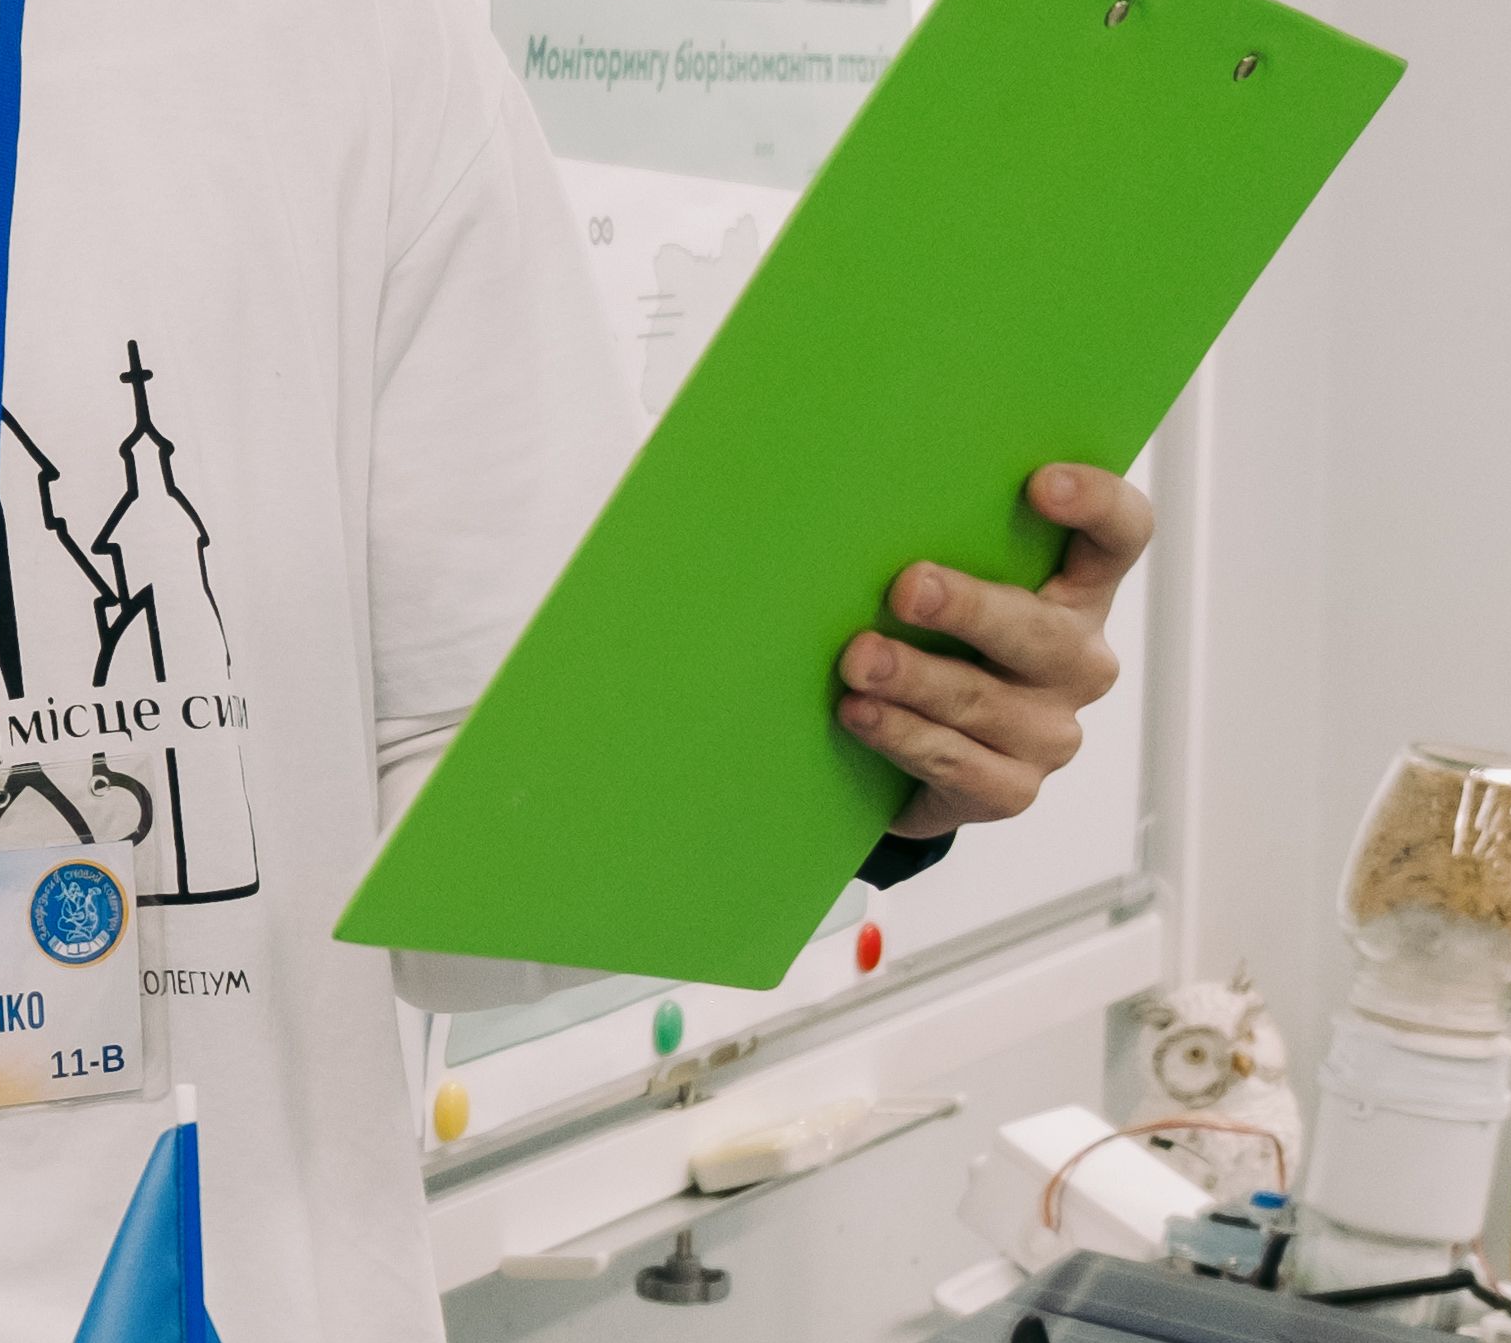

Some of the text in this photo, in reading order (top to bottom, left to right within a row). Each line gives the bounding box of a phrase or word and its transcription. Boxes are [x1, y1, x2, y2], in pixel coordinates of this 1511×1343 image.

[525, 35, 668, 92] Моніторингу
[7, 697, 162, 746] місце
[139, 969, 251, 997] ОЛЕГІУМ
[50, 1044, 126, 1080] 11-В
